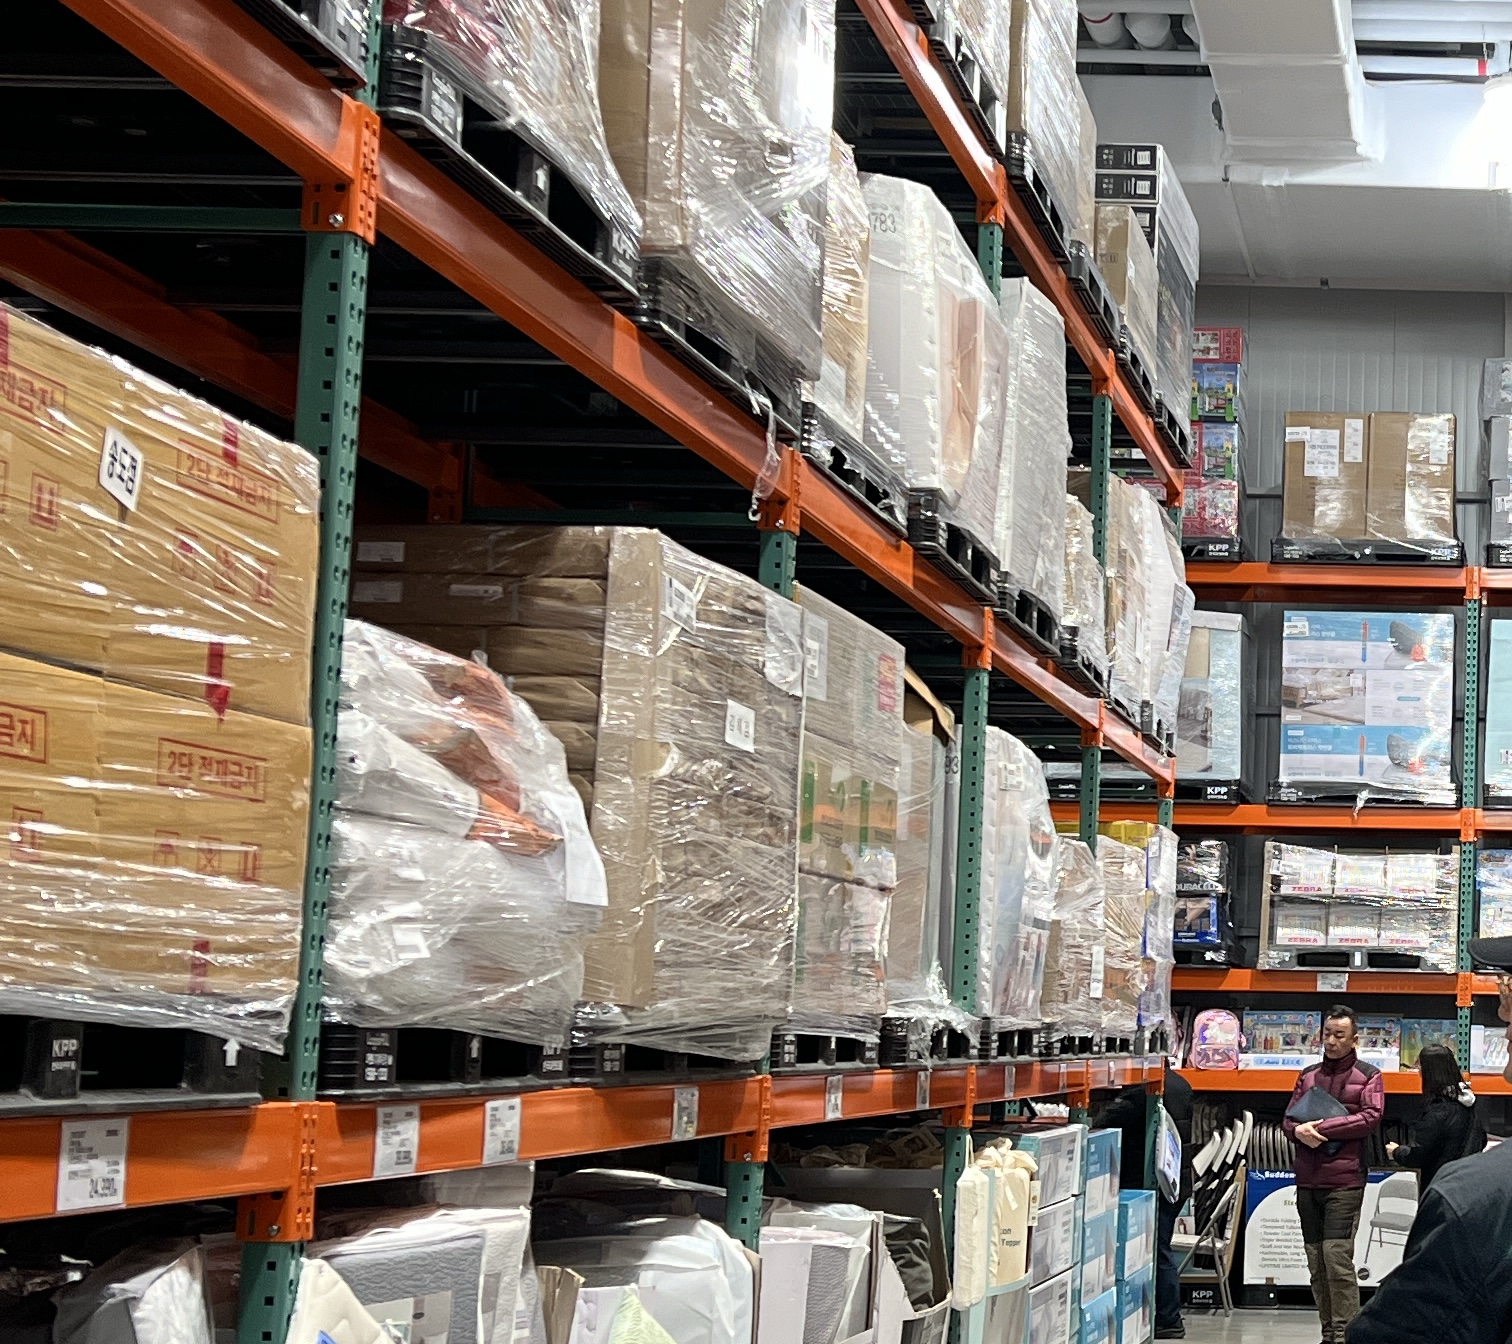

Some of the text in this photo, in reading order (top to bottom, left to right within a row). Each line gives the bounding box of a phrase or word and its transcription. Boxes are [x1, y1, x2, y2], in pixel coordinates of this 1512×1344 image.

[107, 440, 138, 496] 송도점
[1209, 544, 1230, 552] KPP
[168, 750, 194, 780] 2단
[1207, 786, 1229, 795] KPP
[52, 1039, 79, 1057] KPP
[1192, 1289, 1214, 1299] KPP
